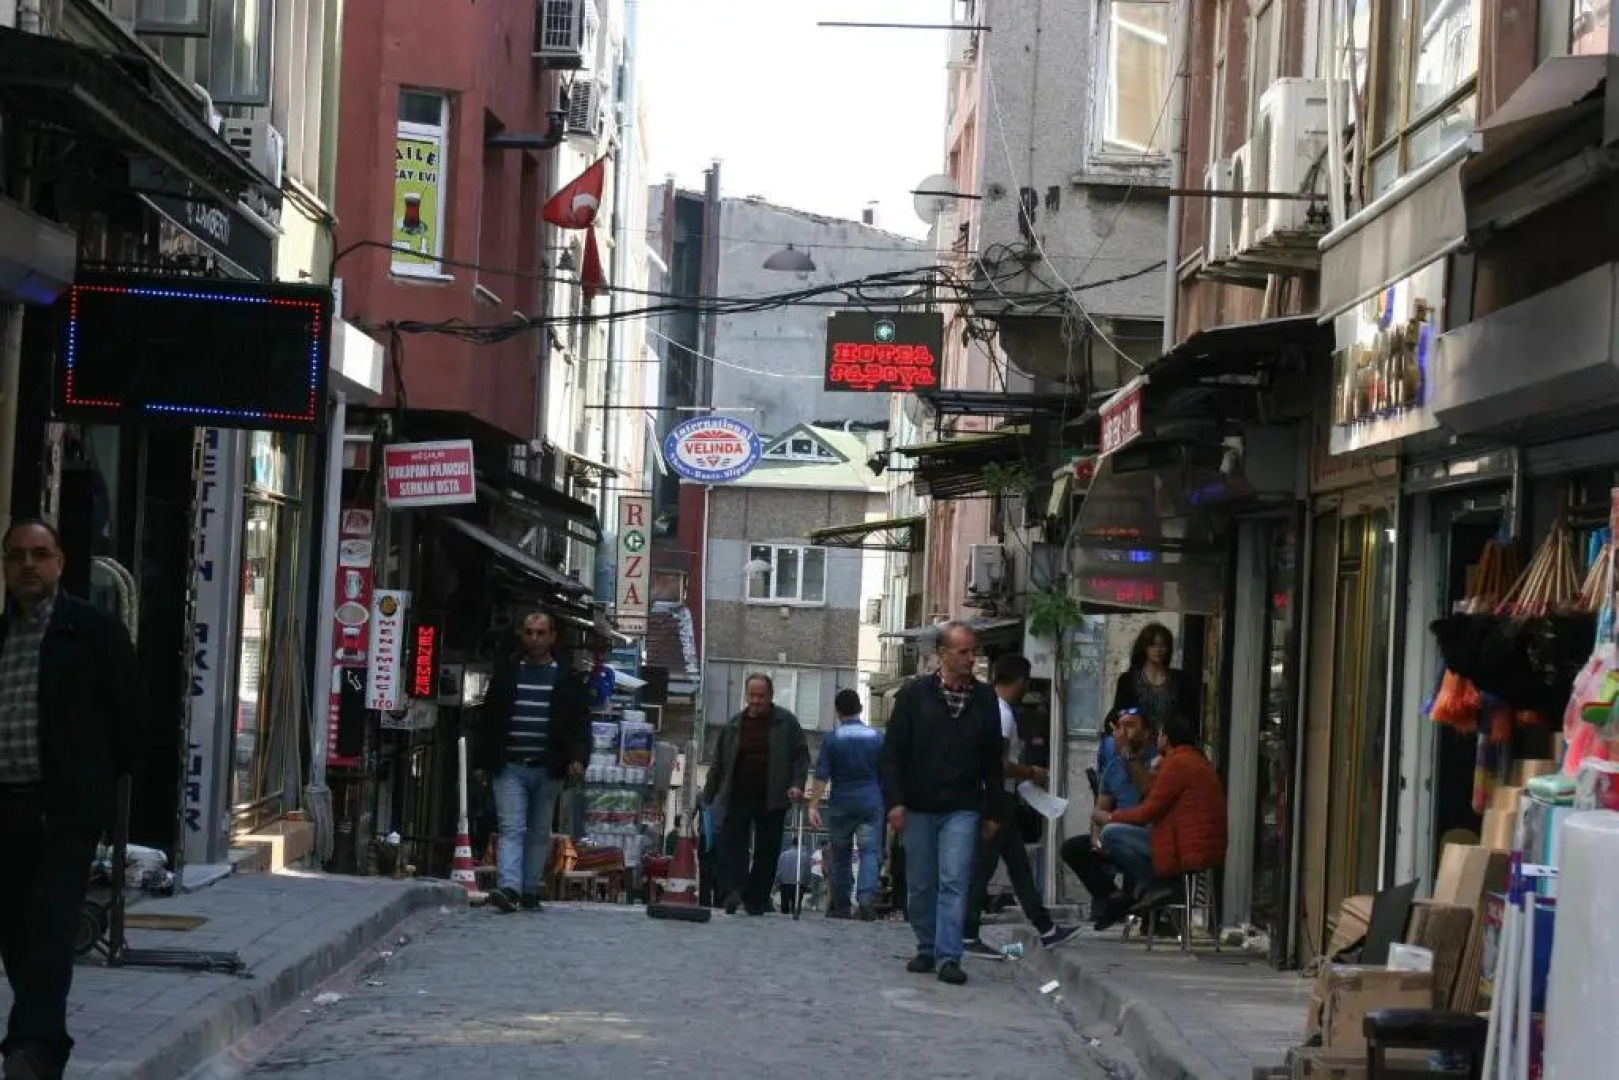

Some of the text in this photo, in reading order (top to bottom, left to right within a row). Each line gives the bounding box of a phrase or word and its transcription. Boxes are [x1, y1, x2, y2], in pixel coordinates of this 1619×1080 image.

[833, 342, 935, 365] HOTEL
[673, 418, 753, 440] International
[684, 442, 744, 455] VELINDA
[623, 503, 646, 605] ROZA
